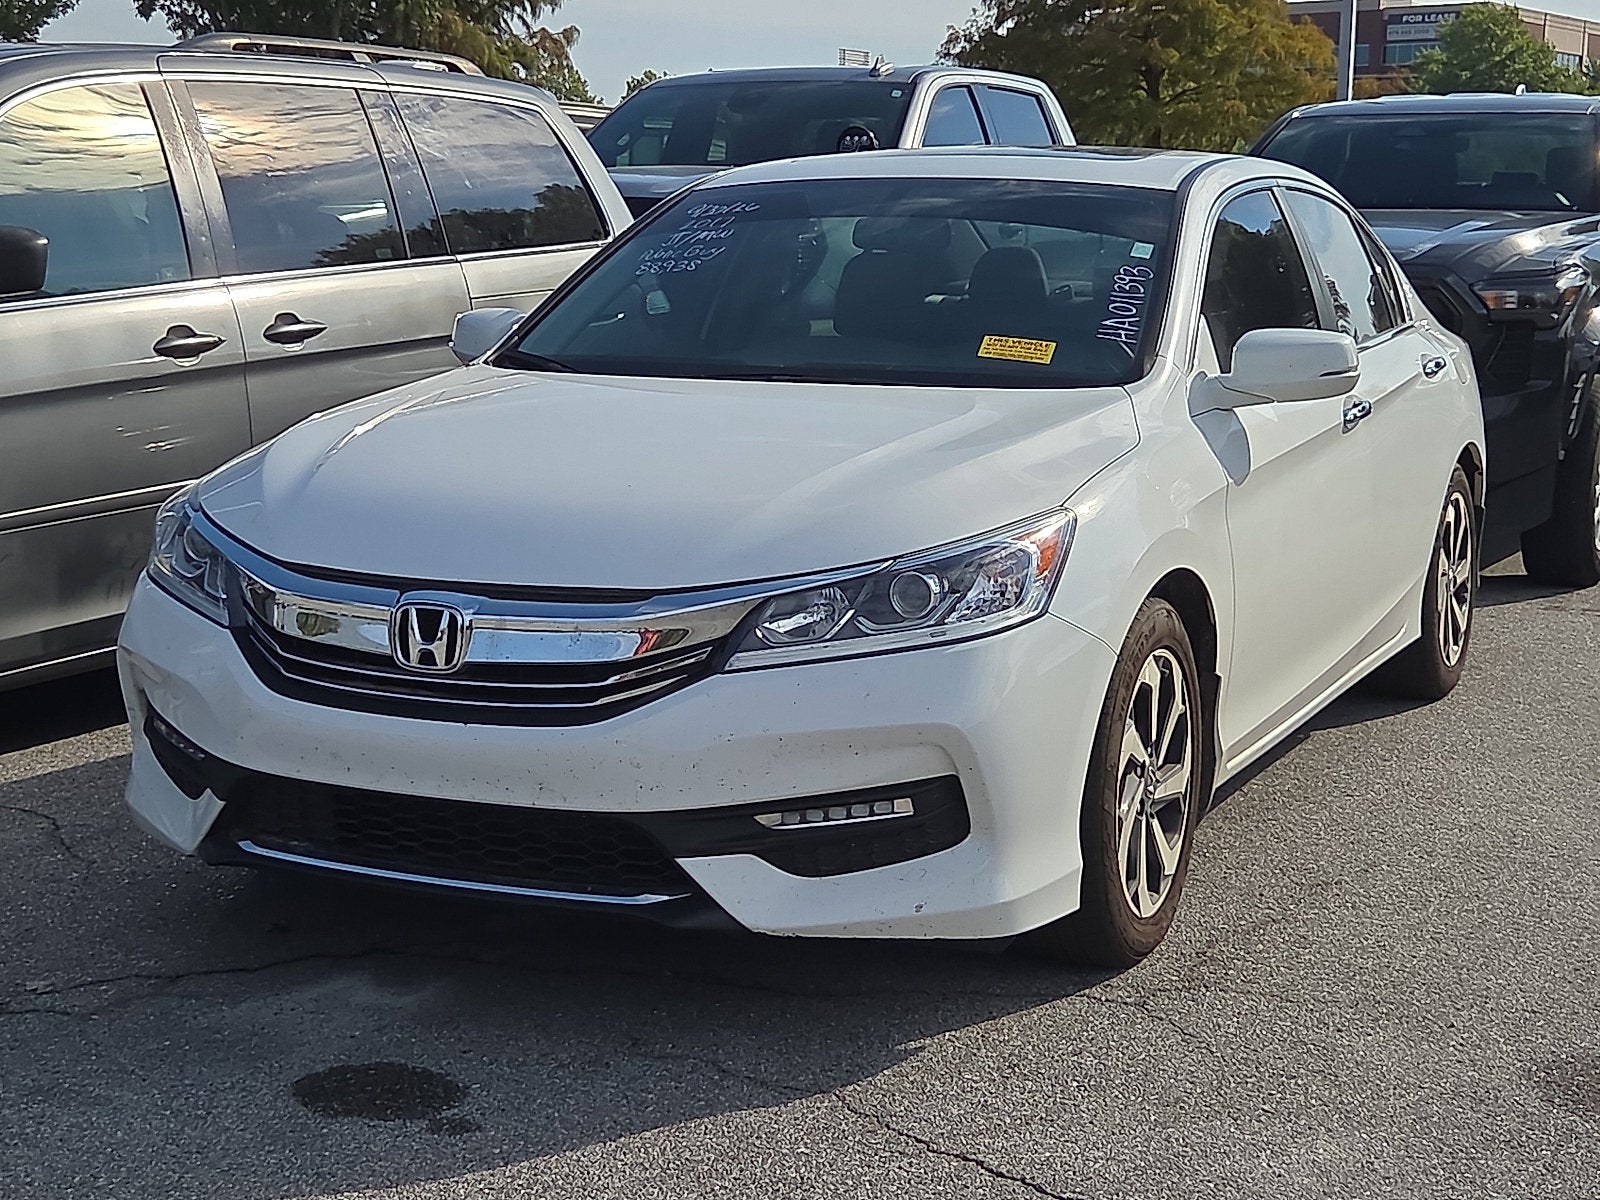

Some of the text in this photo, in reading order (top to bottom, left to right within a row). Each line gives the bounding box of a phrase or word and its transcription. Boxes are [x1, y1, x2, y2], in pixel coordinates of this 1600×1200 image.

[1402, 12, 1456, 23] FOR LEASE
[1095, 265, 1155, 345] HA011393
[1011, 339, 1052, 348] VEHICLE
